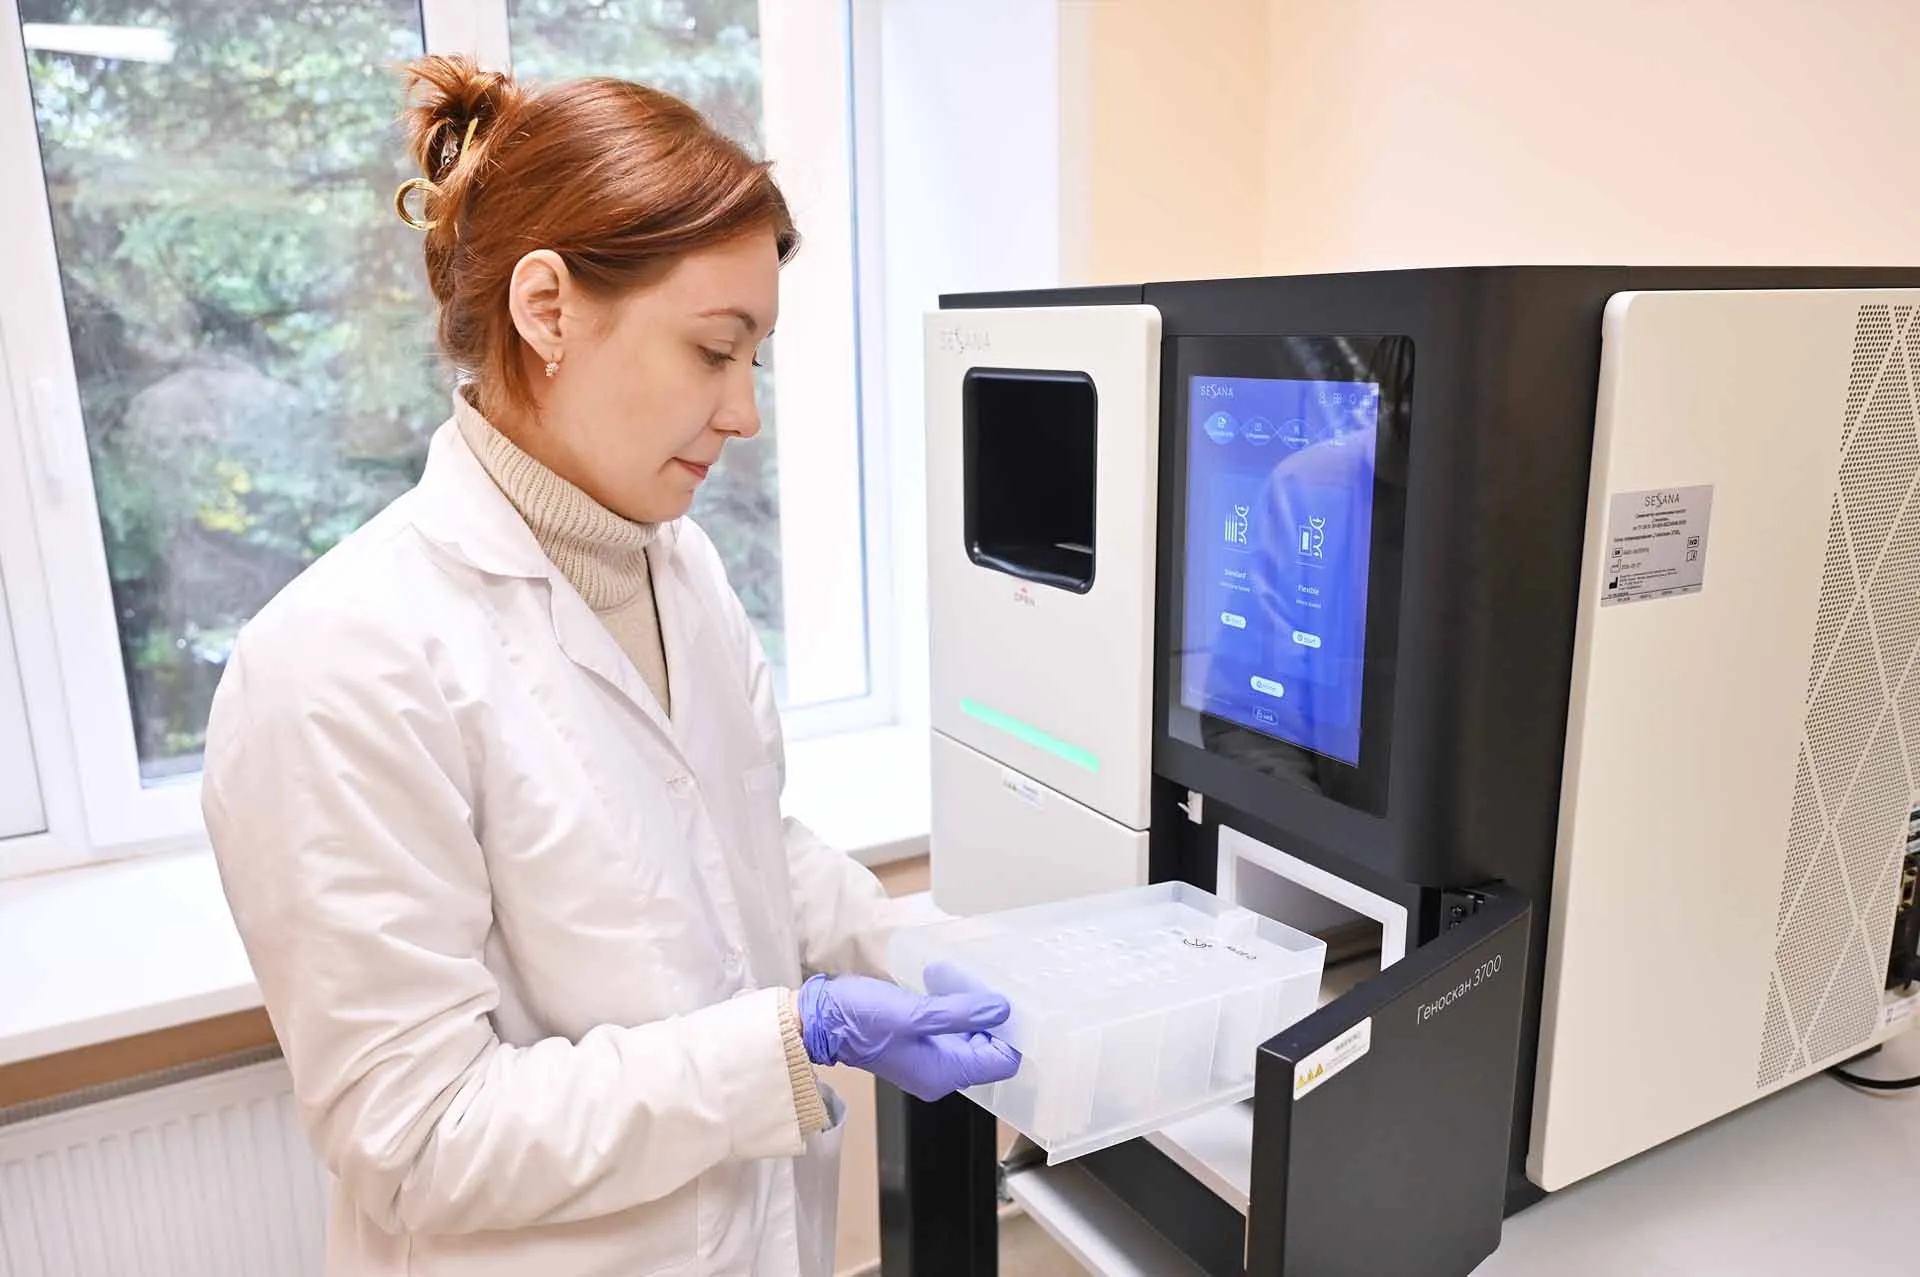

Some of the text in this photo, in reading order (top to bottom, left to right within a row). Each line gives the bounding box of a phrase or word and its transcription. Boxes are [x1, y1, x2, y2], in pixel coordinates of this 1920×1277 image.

[1644, 492, 1680, 507] SESANA
[1417, 954, 1502, 1025] Геноскан 3700
